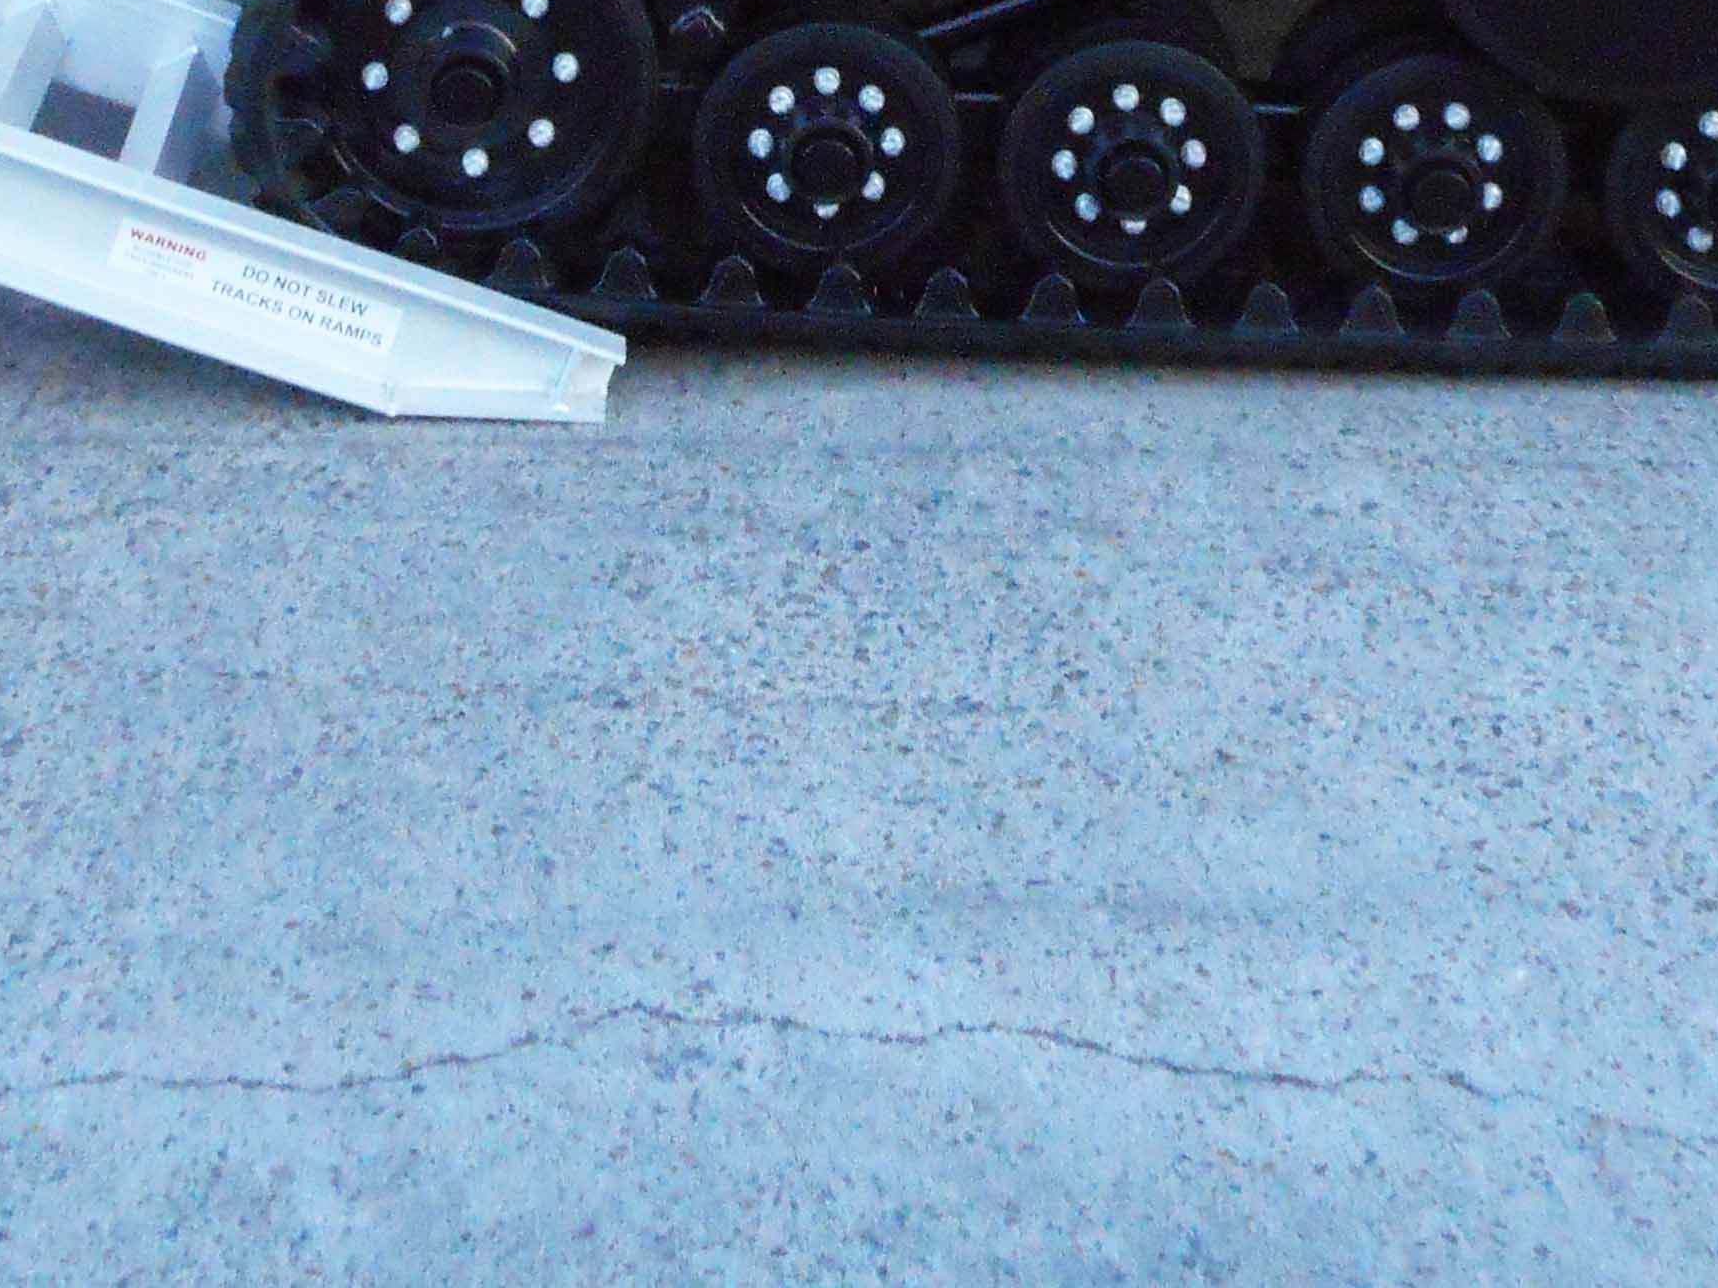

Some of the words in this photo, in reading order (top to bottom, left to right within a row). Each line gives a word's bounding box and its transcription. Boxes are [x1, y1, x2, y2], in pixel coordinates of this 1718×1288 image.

[130, 227, 208, 263] WARNING
[210, 279, 284, 315] TRACKS
[287, 303, 316, 326] ON
[320, 316, 383, 346] RAMPS
[241, 264, 271, 285] DO
[272, 272, 312, 299] NOT
[314, 286, 370, 318] SLEW
